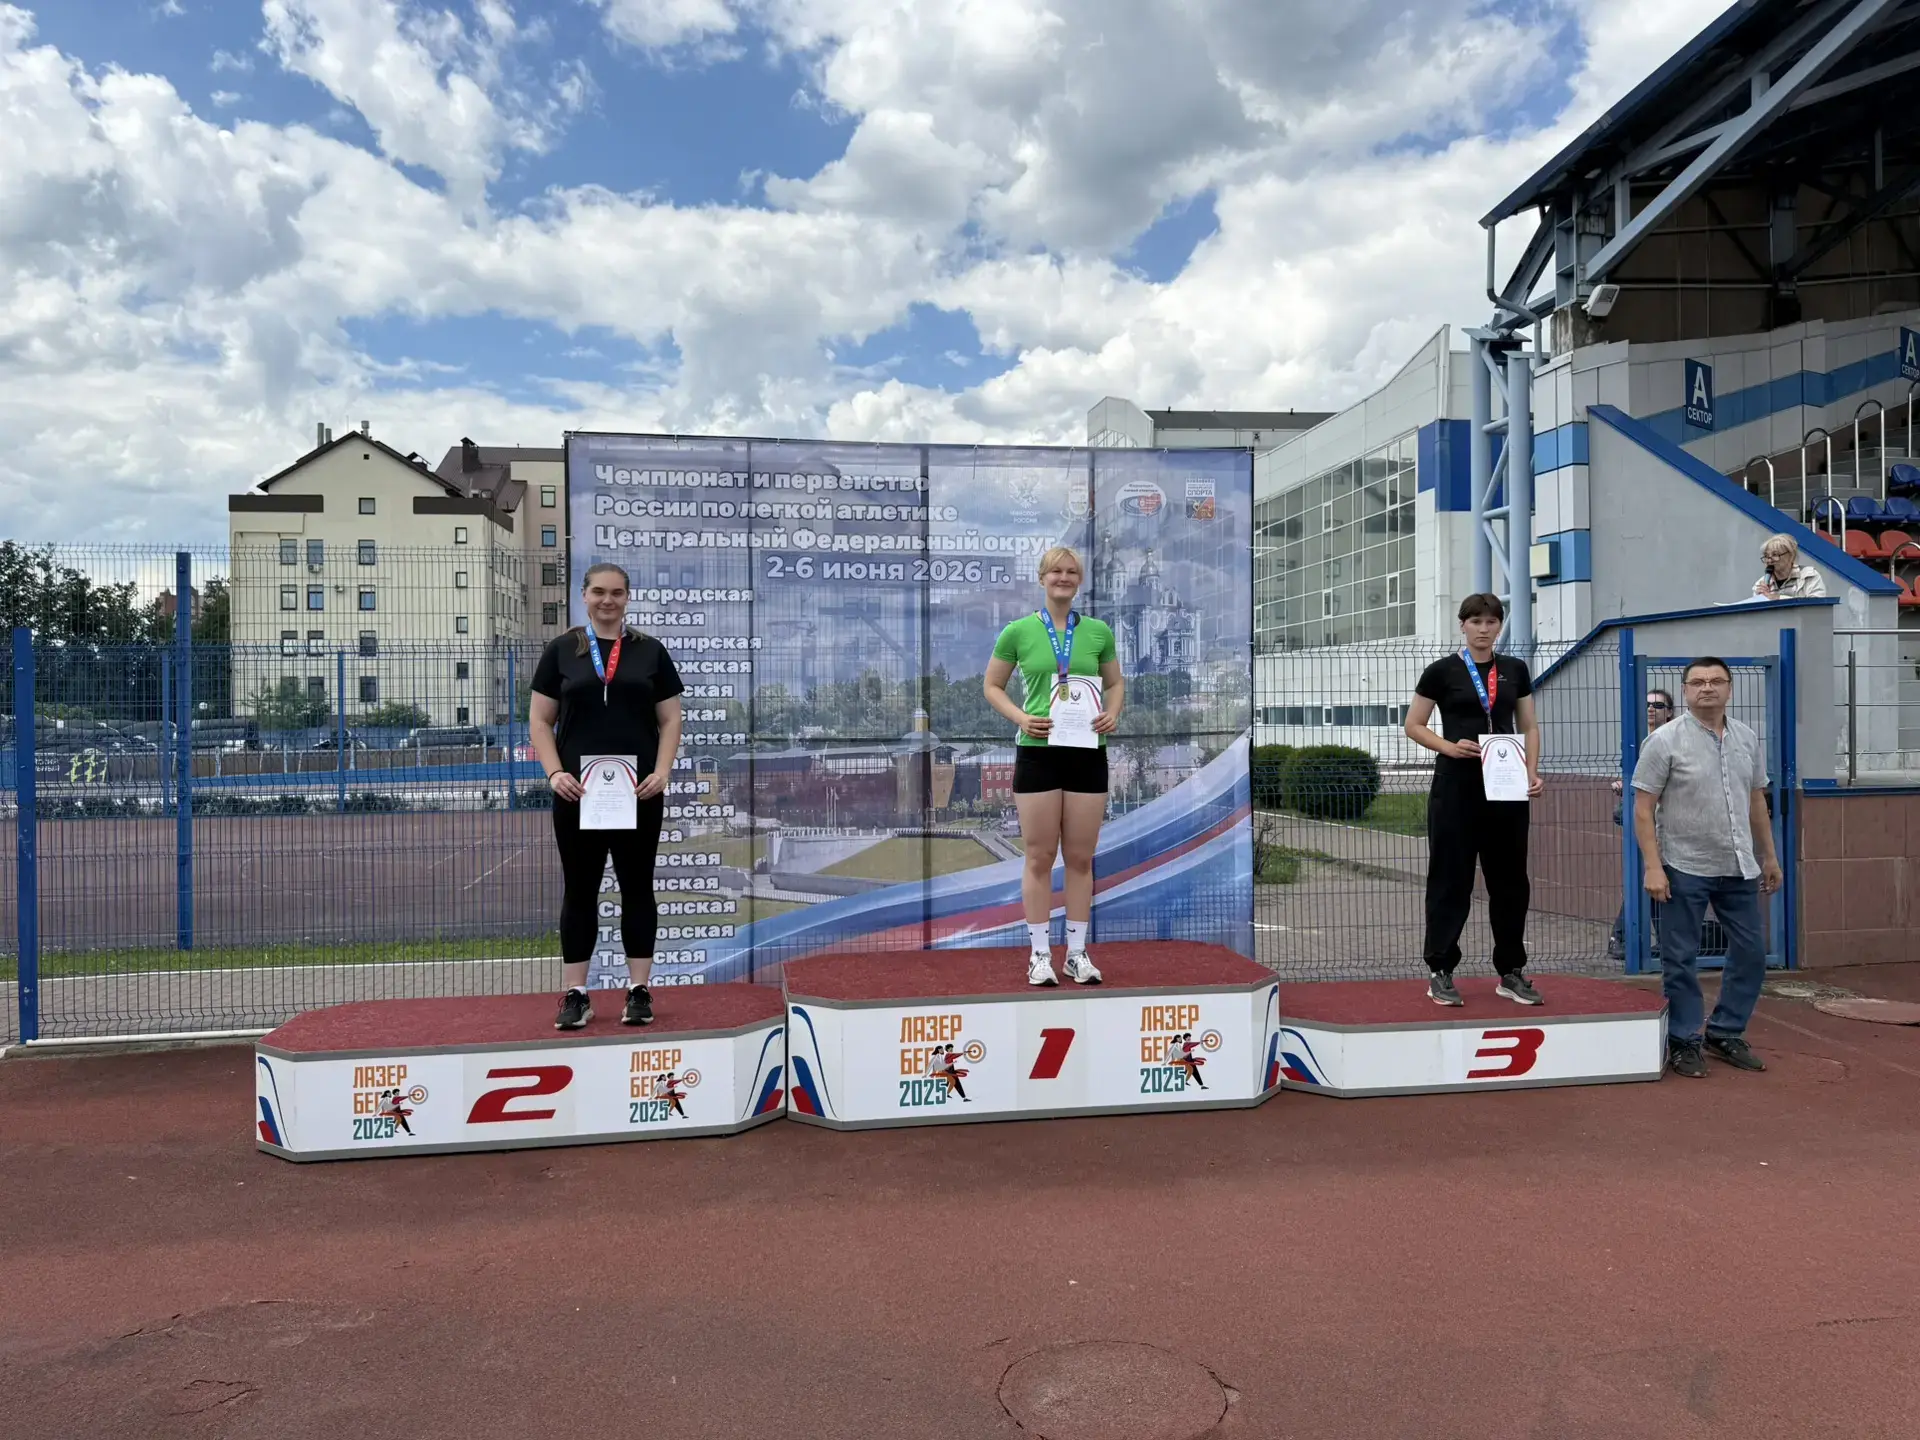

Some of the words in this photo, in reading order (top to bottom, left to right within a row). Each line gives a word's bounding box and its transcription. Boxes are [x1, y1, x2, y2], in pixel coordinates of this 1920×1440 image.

[1905, 332, 1917, 366] А
[1692, 365, 1709, 409] А
[1687, 406, 1713, 425] СЕКТОР
[594, 464, 750, 488] Чемпионат
[753, 471, 770, 489] и
[774, 473, 930, 495] первенство
[594, 494, 698, 518] России
[701, 500, 736, 518] по
[738, 498, 833, 522] легкой
[836, 503, 959, 522] атлетике
[594, 524, 788, 553] Центральный
[791, 528, 980, 555] Федеральный
[983, 533, 1056, 557] округ
[765, 555, 815, 580] 2-6
[822, 561, 905, 581] июня
[911, 558, 983, 583] 2026
[988, 563, 1012, 584] г.
[628, 587, 754, 606] лгородская
[624, 611, 705, 626] янская
[899, 1014, 962, 1043] ЛАЗЕР
[1139, 1004, 1200, 1031] ЛАЗЕР
[630, 1048, 682, 1073] ЛАЗЕР
[900, 1046, 935, 1075] БЕГ
[1029, 1027, 1075, 1079] 1
[1140, 1035, 1173, 1063] БЕГ
[1466, 1028, 1545, 1079] 3
[353, 1064, 407, 1088] ЛАЗЕР
[630, 1075, 659, 1098] БЕГ
[1140, 1066, 1185, 1094] 2025
[353, 1091, 382, 1115] БЕГ
[466, 1064, 574, 1124] 2
[899, 1078, 947, 1107] 2025
[629, 1099, 668, 1124] 2025
[353, 1116, 394, 1140] 2025
